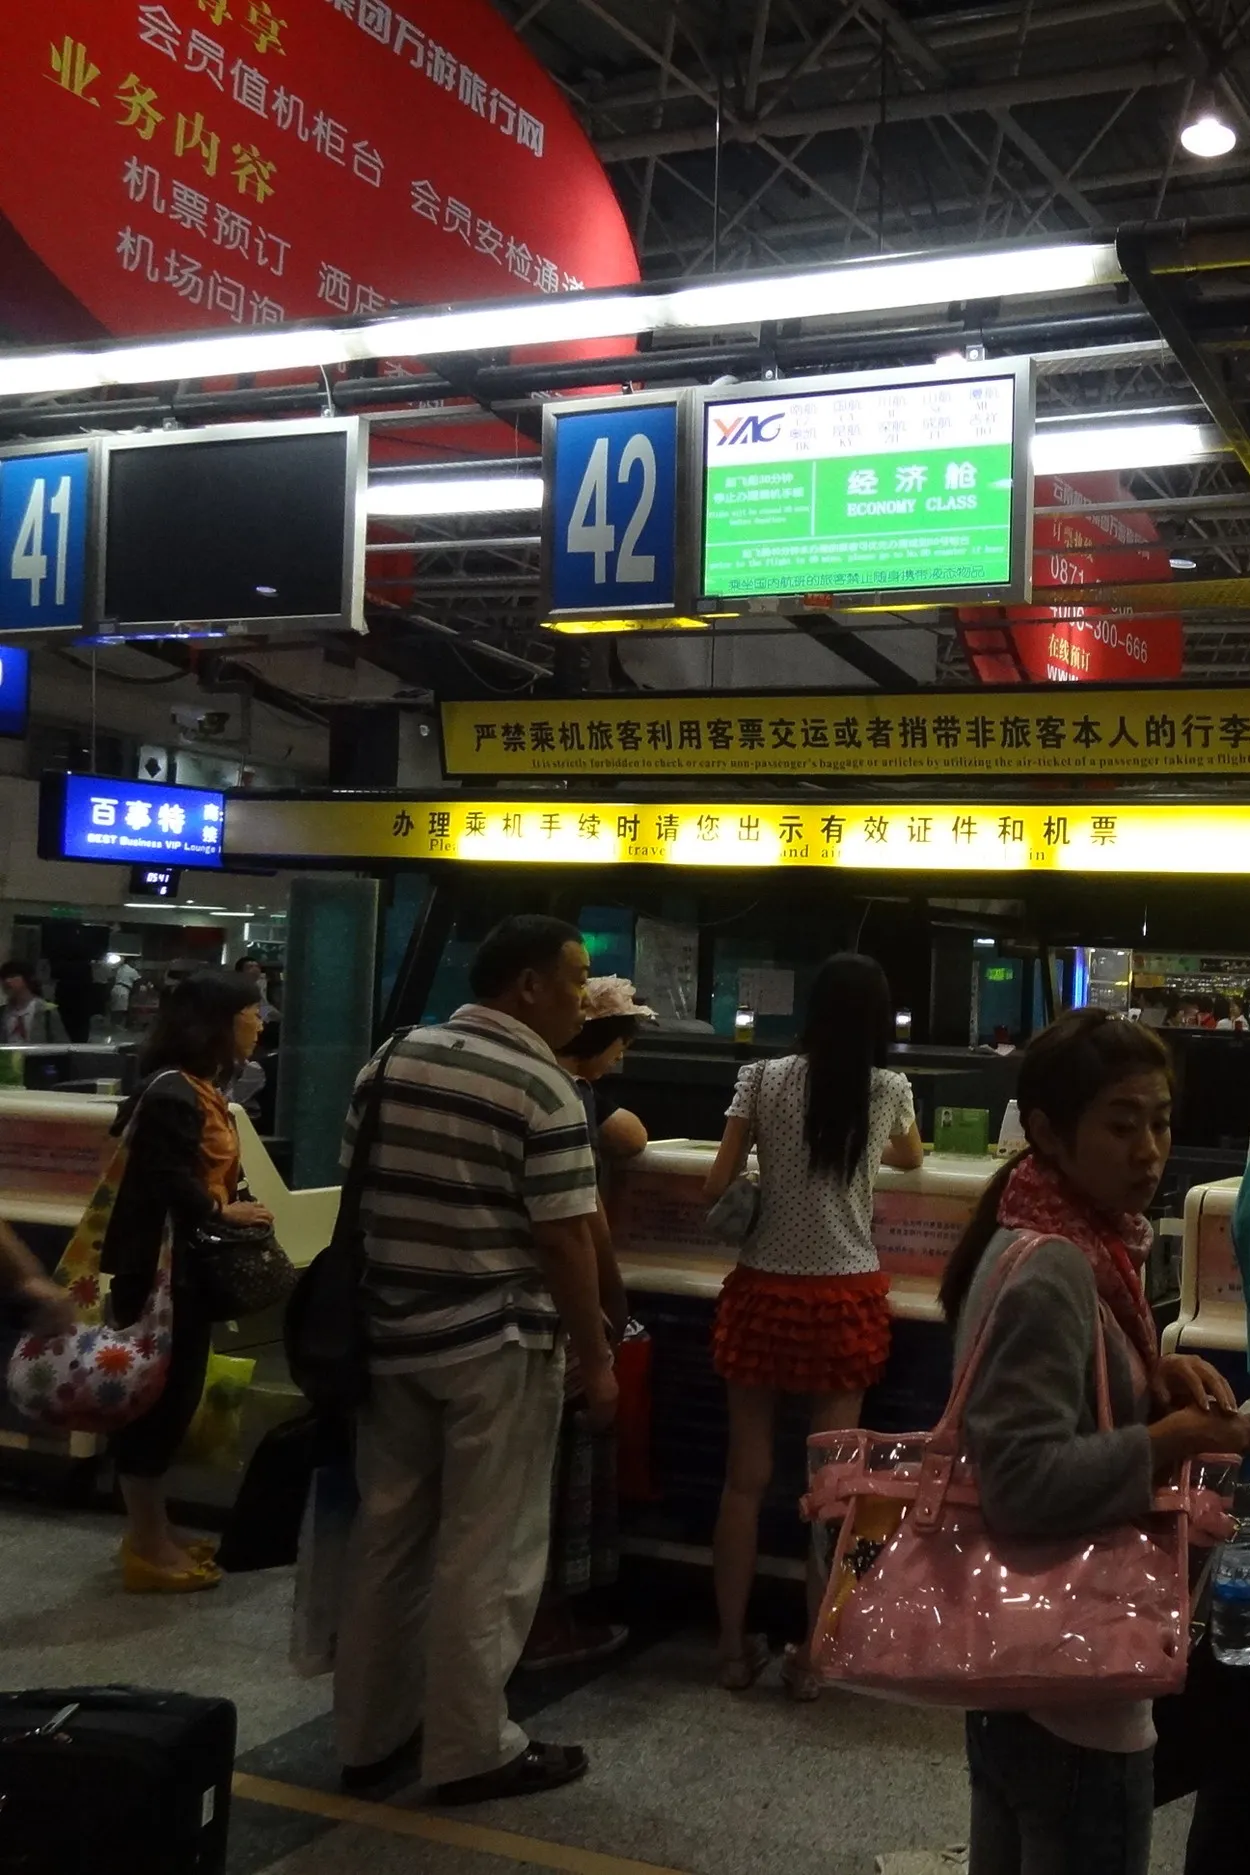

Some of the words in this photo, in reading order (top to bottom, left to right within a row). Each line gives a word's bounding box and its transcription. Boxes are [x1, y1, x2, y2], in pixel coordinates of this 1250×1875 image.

[138, 4, 384, 187] 会员值机柜台
[41, 35, 277, 203] 业务内容
[122, 155, 291, 276] 机票预订
[713, 412, 785, 446] YAC
[846, 461, 978, 497] 经济舱
[567, 433, 656, 584] 42
[846, 498, 917, 517] ECONOMY
[926, 494, 978, 513] CLASS
[11, 475, 71, 606] 41
[1049, 633, 1091, 672] 在线预订
[165, 840, 182, 850] VIP
[184, 842, 216, 854] Lounge
[392, 809, 1118, 846] 办理乘机手续时请您出示有效证件和机票
